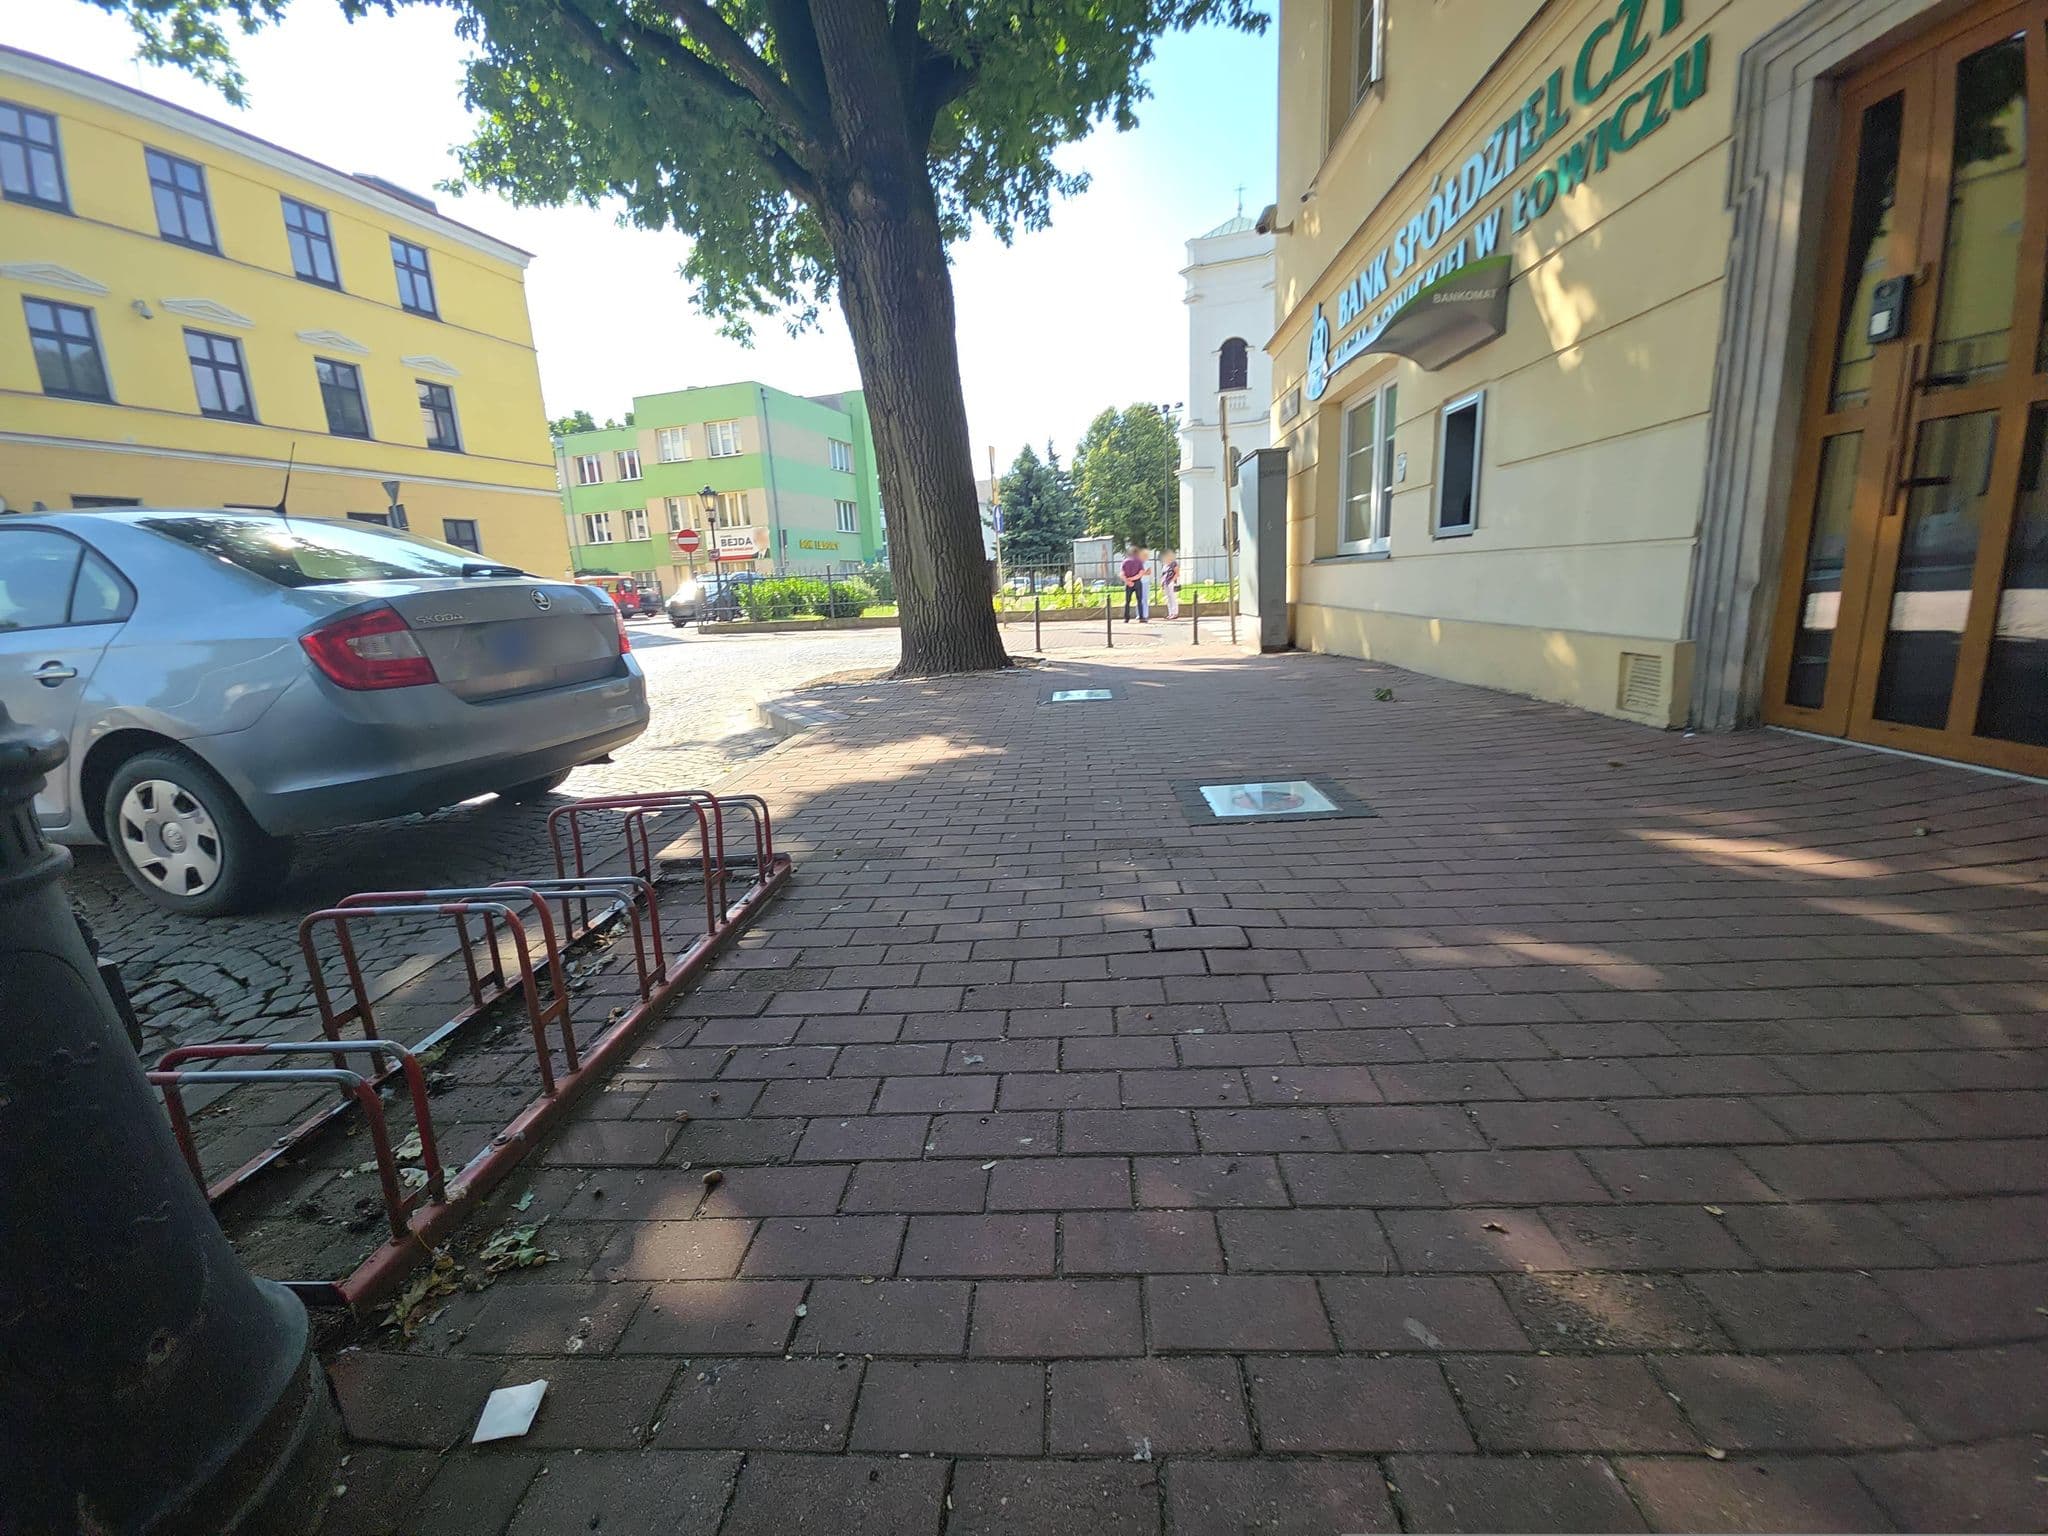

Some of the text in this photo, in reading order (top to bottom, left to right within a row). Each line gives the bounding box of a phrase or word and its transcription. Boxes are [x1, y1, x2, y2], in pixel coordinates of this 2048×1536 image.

[1474, 206, 1501, 259] W
[1511, 33, 1711, 236] ŁOWICZU
[1338, 248, 1389, 331] BANK
[1433, 288, 1497, 304] BANKOMAT
